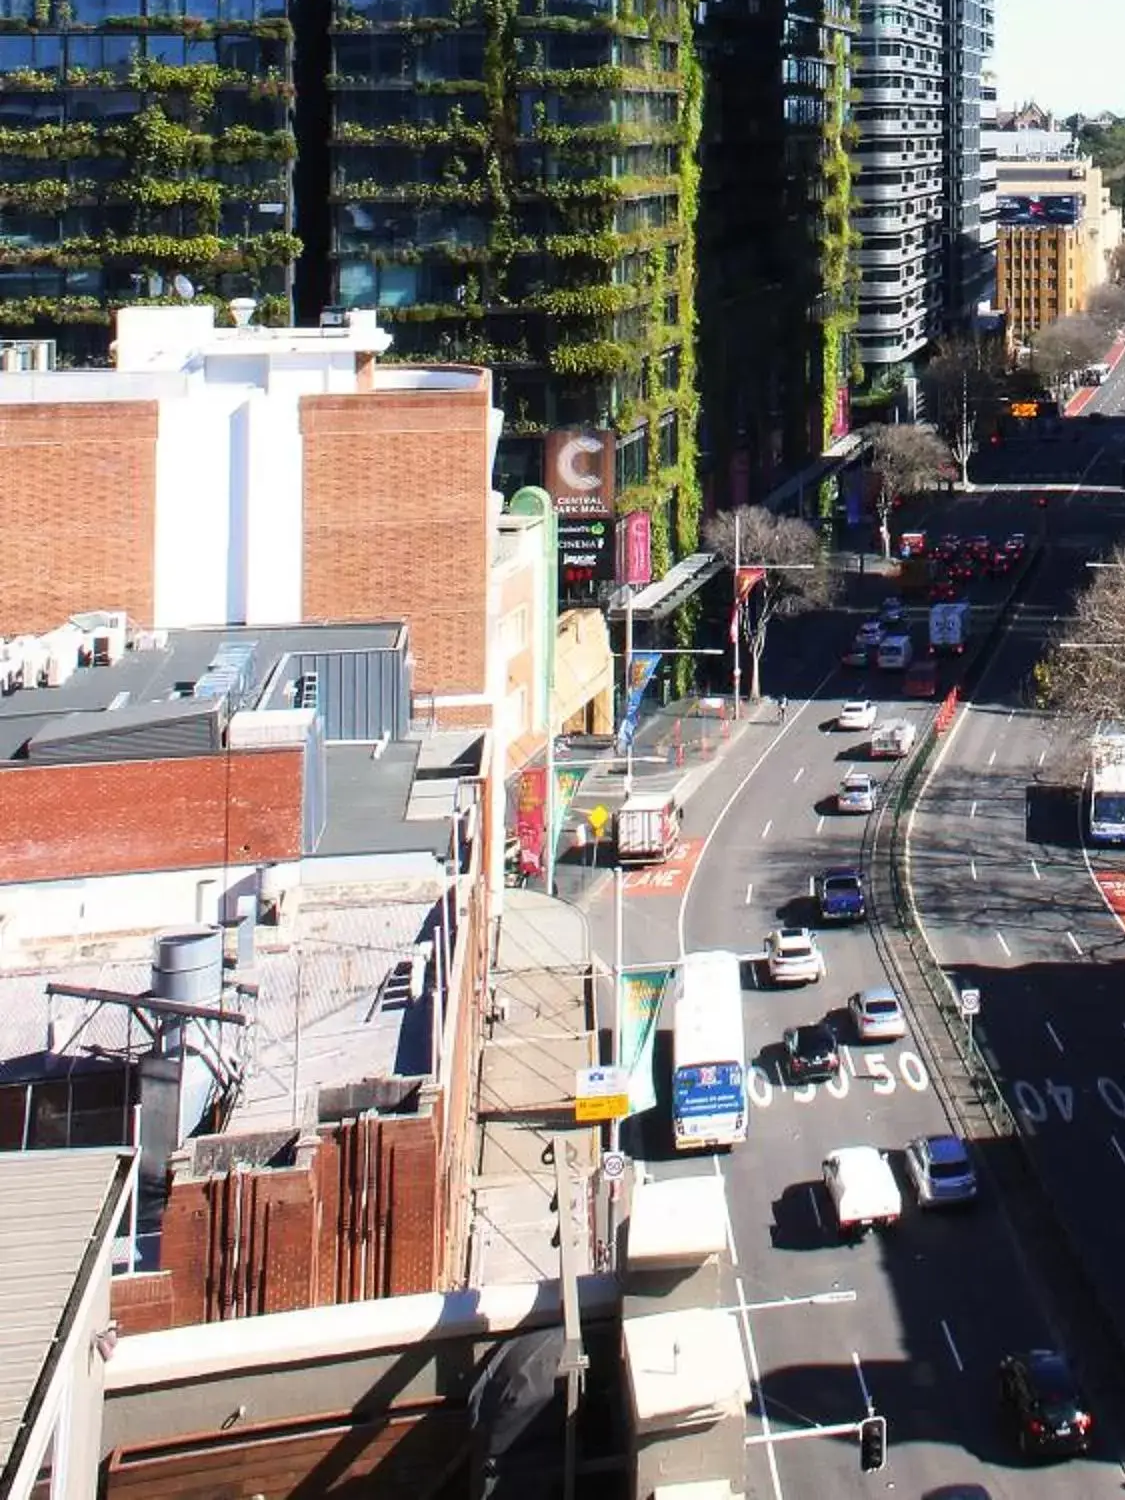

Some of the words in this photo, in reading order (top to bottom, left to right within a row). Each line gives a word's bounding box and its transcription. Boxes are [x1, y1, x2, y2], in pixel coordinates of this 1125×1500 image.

[557, 496, 603, 504] CENTRAL
[580, 505, 608, 513] MALL
[622, 869, 681, 889] LANE
[864, 1051, 929, 1095] 50
[1013, 1077, 1074, 1123] 40
